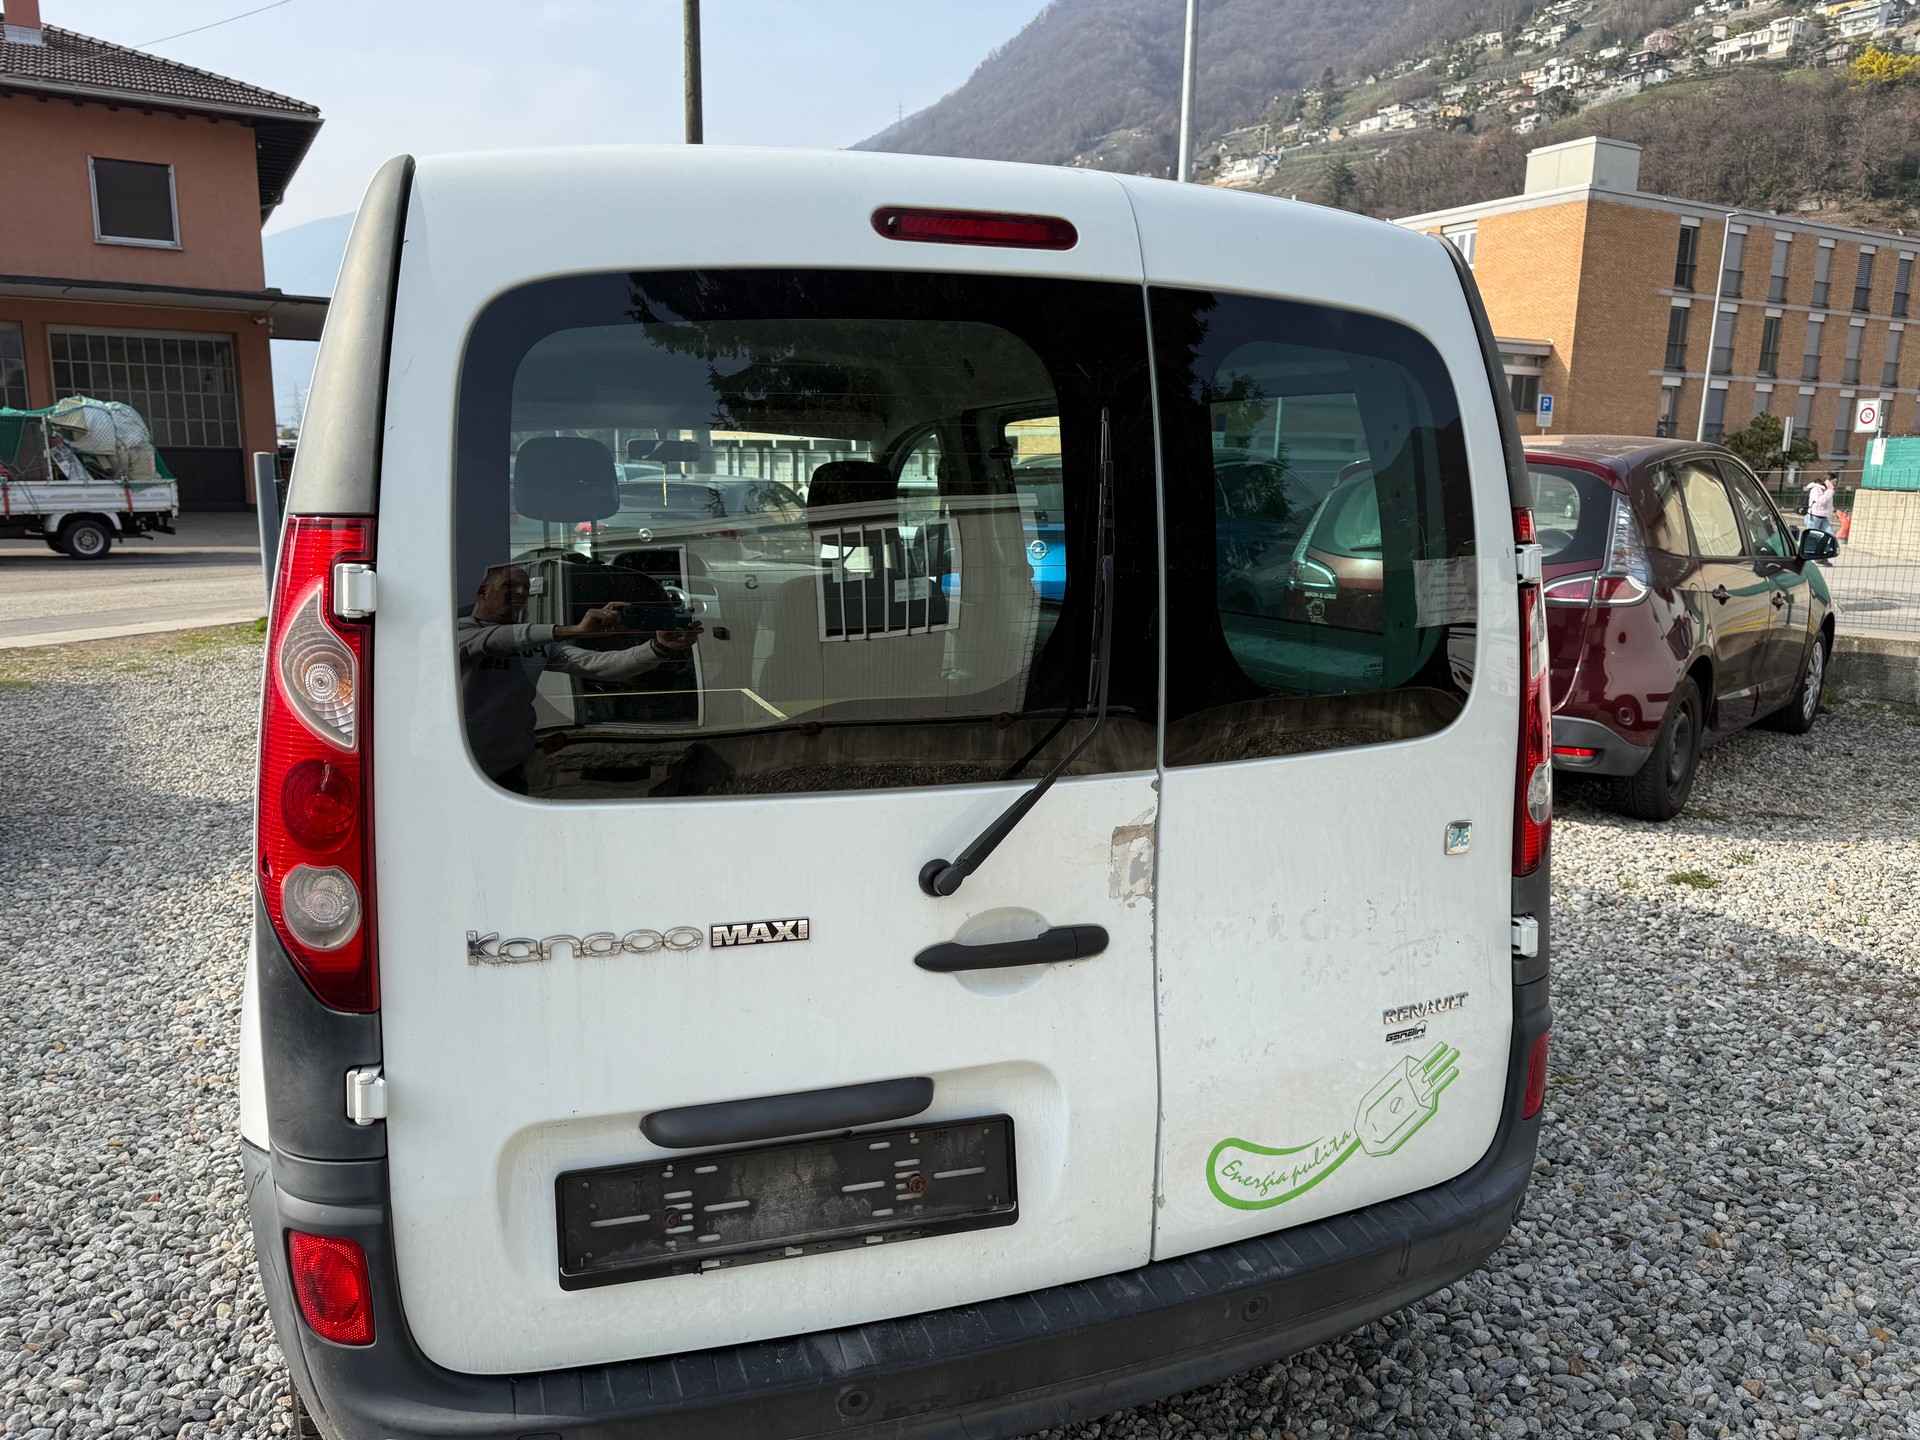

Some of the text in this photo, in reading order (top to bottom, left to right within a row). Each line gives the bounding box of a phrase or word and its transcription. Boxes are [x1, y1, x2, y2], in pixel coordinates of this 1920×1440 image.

[1542, 398, 1550, 410] P
[711, 918, 809, 947] MAXI
[1383, 991, 1469, 1025] RENAULT
[1221, 1131, 1351, 1196] Energia pulita
